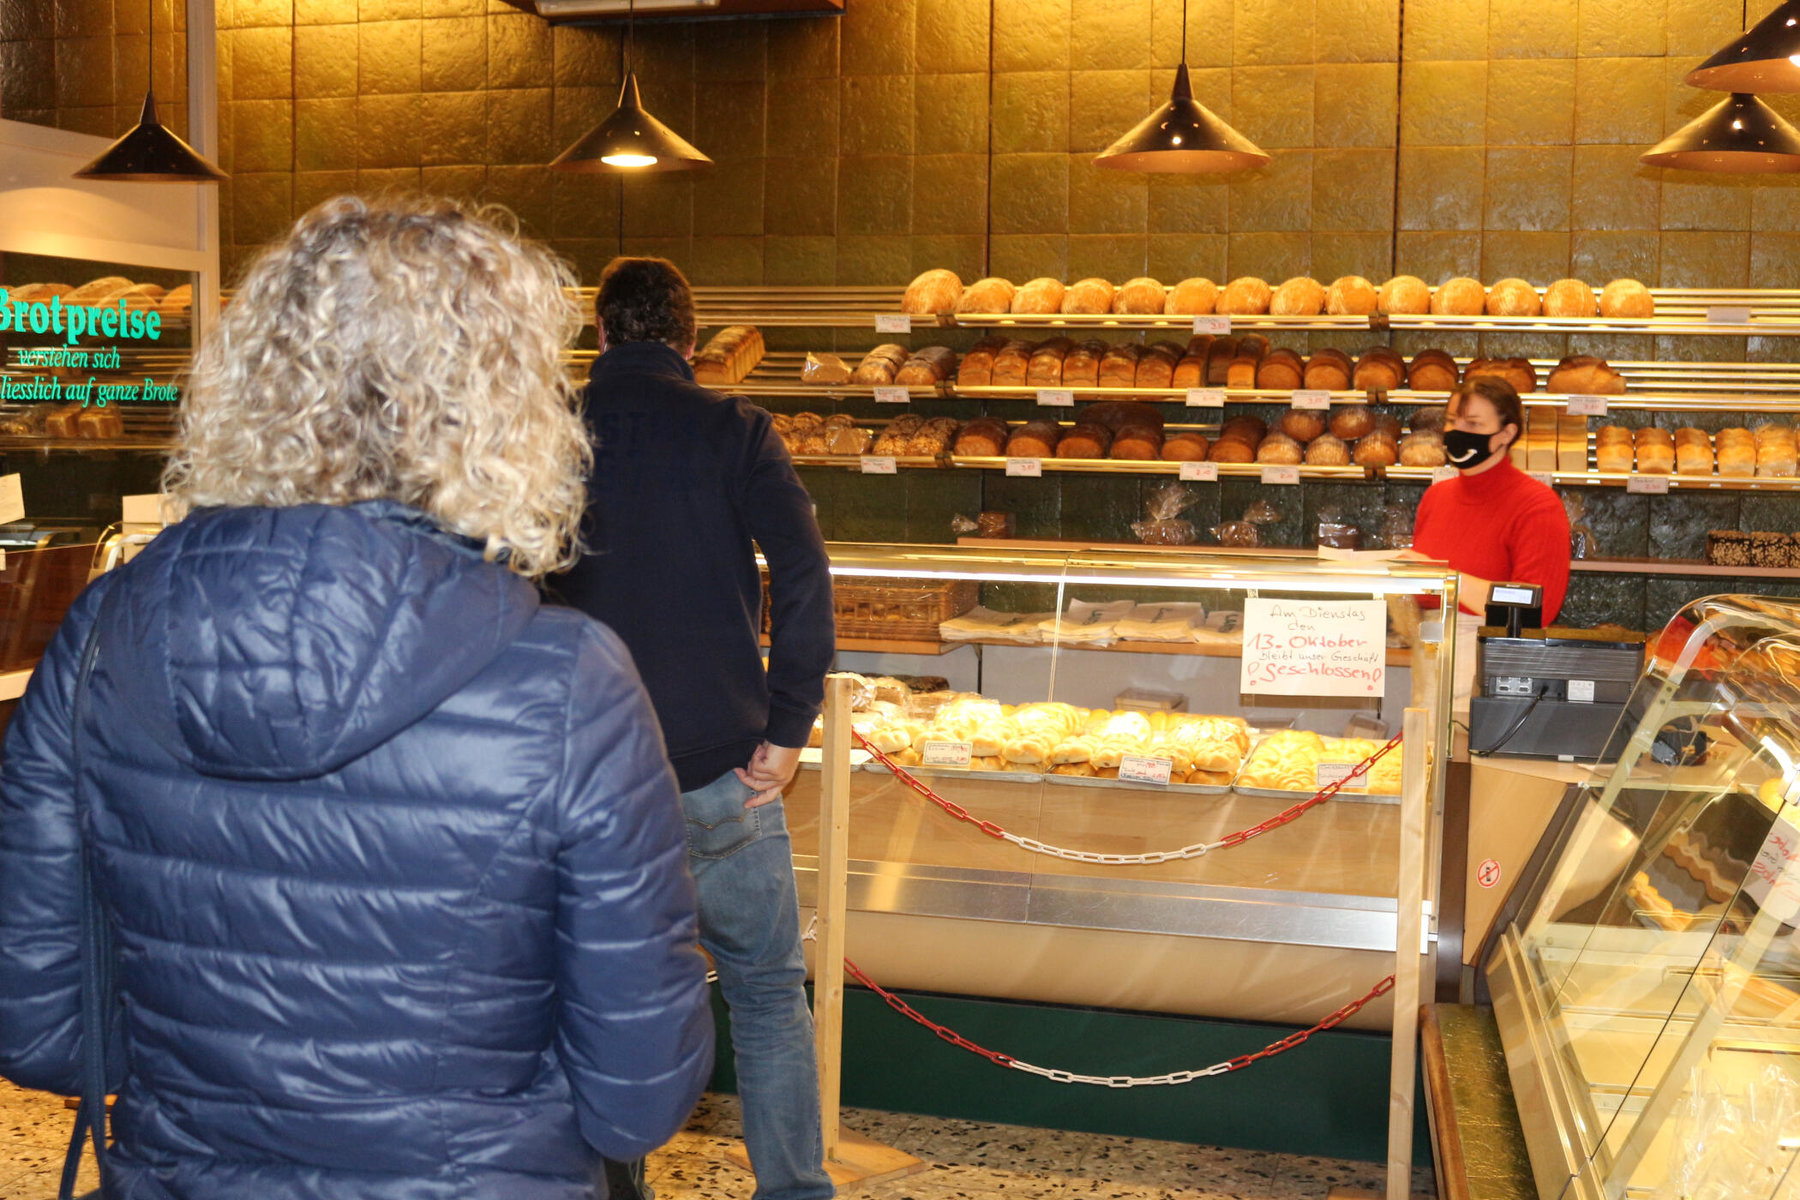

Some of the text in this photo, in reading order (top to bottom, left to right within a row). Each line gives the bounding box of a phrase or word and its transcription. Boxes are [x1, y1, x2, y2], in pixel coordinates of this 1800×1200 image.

[18, 343, 121, 369] verstehen sich
[65, 376, 96, 408] auf
[97, 385, 139, 408] ganze
[142, 378, 178, 401] Brote
[1270, 604, 1296, 619] Am
[1247, 633, 1368, 650] 13. Oktober
